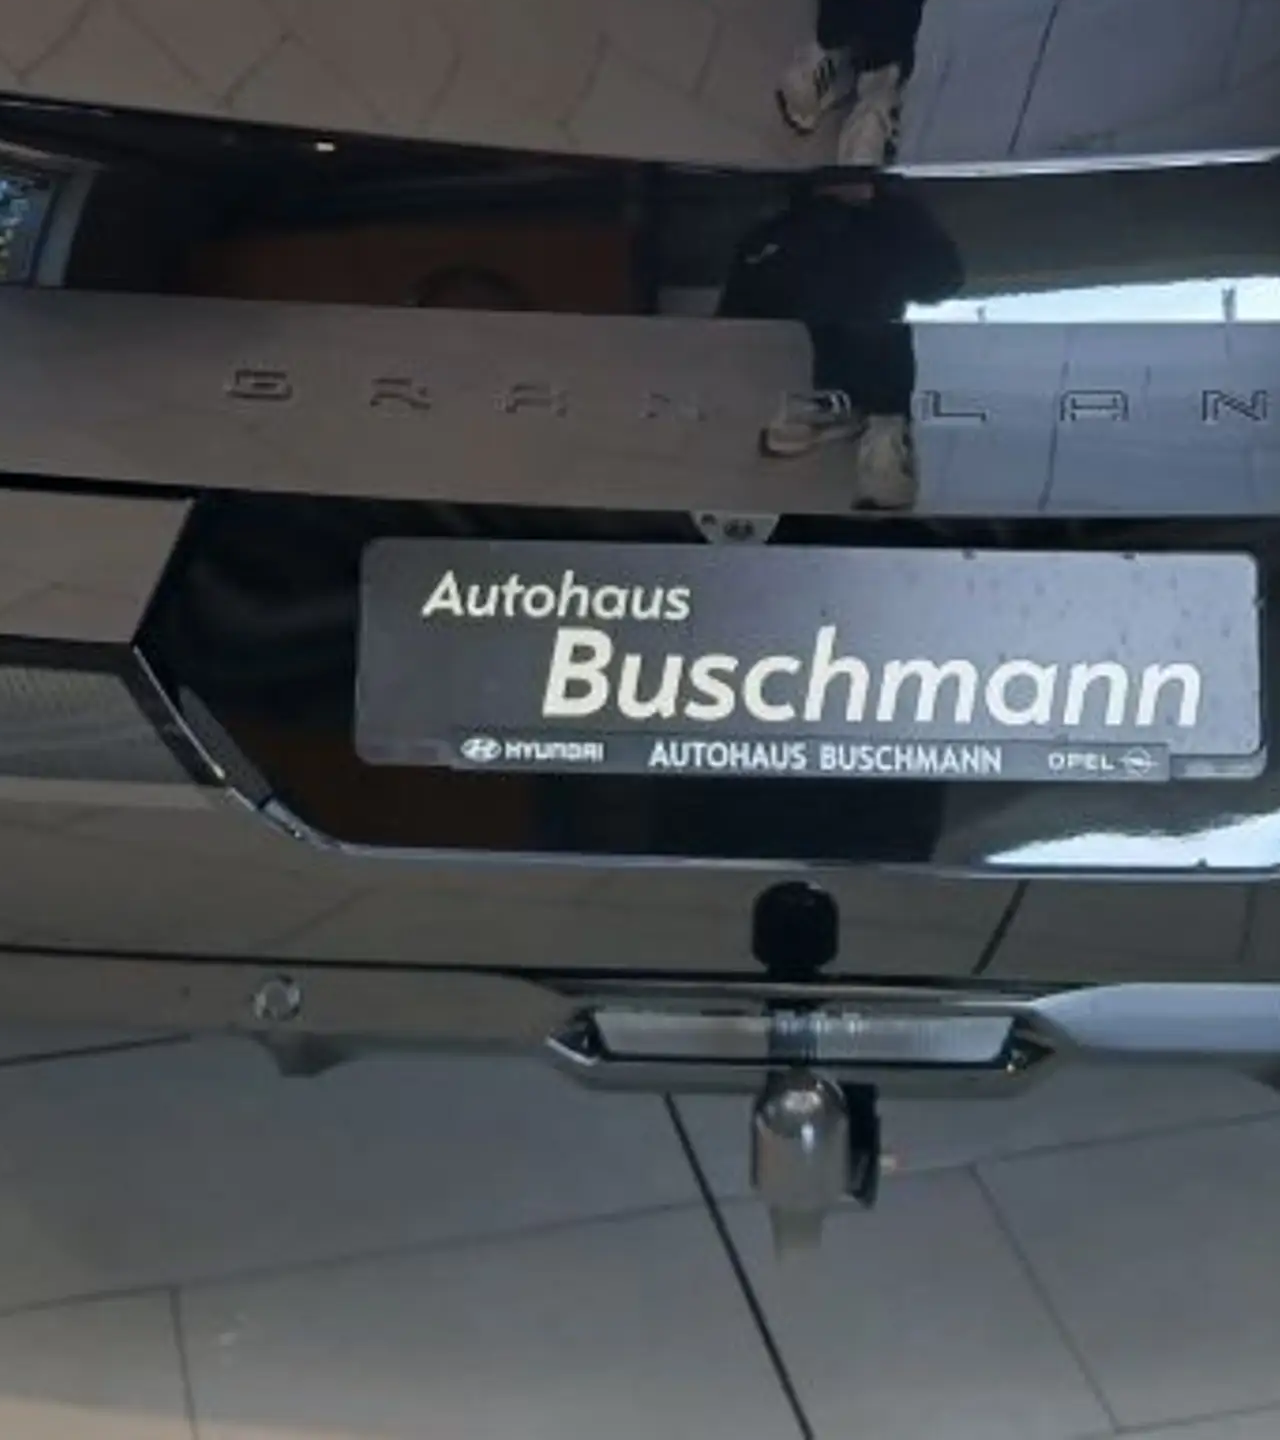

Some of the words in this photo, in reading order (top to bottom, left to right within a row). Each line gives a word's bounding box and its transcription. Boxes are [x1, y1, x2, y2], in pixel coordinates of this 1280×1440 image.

[422, 570, 692, 620] Autohaus
[540, 625, 1203, 728] Buschmann
[504, 741, 604, 764] HYUNDAI
[648, 740, 807, 771] AUTOHAUS
[820, 743, 1003, 774] BUSCHMANN
[1048, 753, 1115, 771] OPEL
